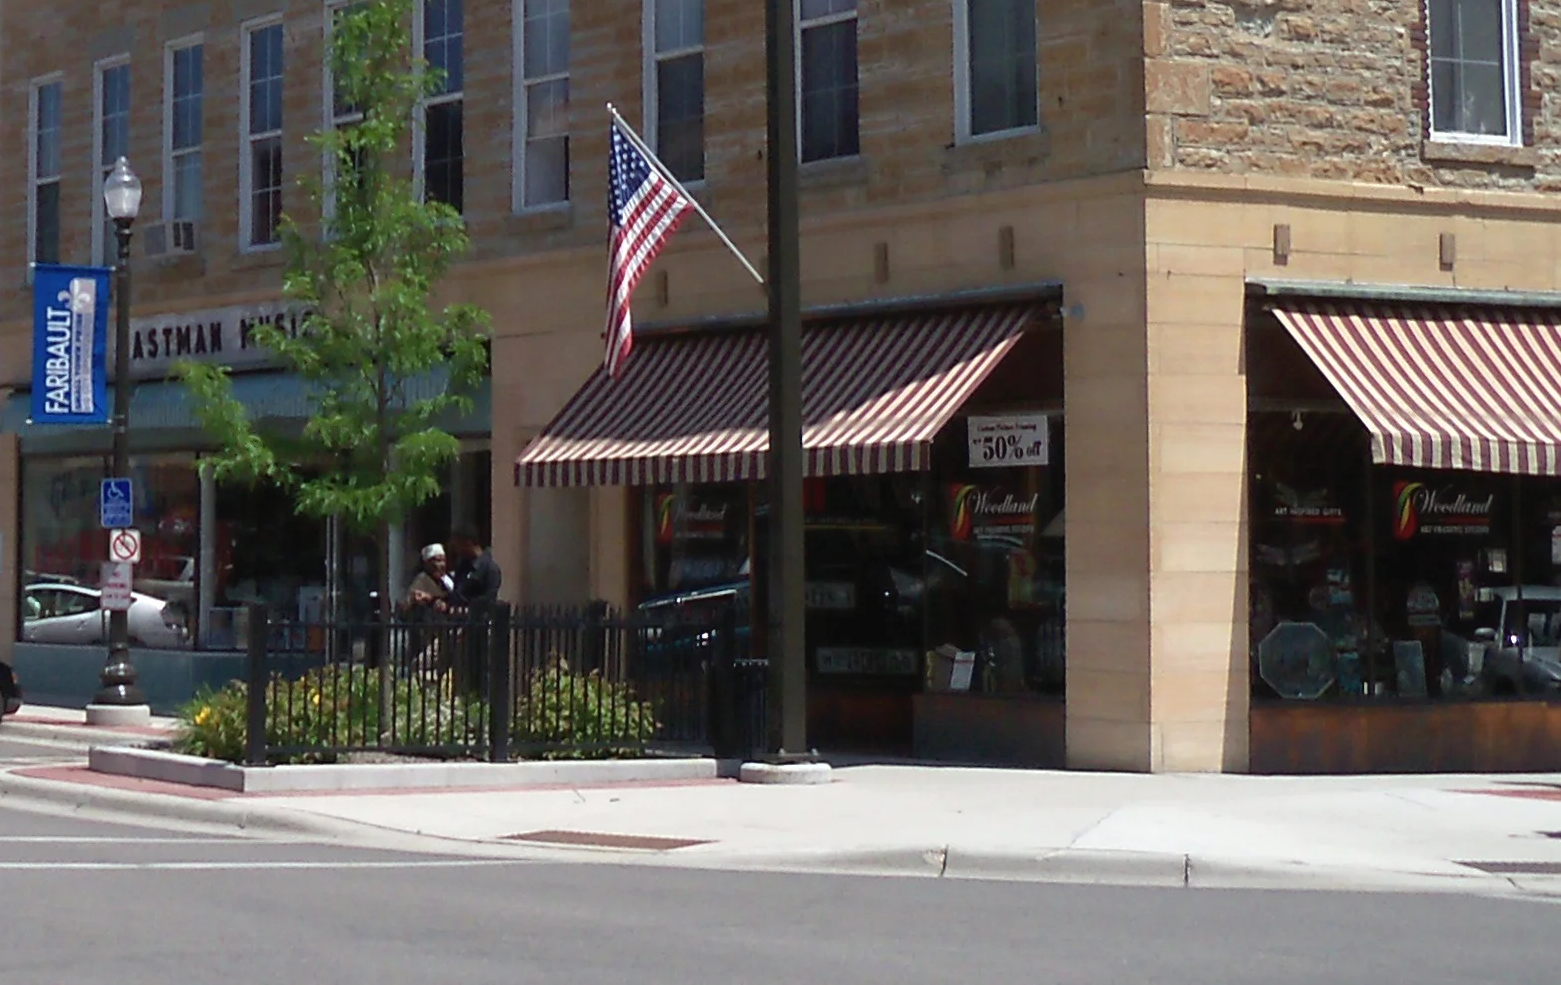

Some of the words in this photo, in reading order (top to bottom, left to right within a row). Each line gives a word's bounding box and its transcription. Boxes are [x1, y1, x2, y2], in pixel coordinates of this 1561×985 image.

[117, 321, 222, 360] ASTMAN
[44, 306, 71, 414] FARIBAULT
[983, 434, 1024, 461] 50%
[967, 489, 1038, 514] Woodland
[1413, 489, 1493, 514] Woodland
